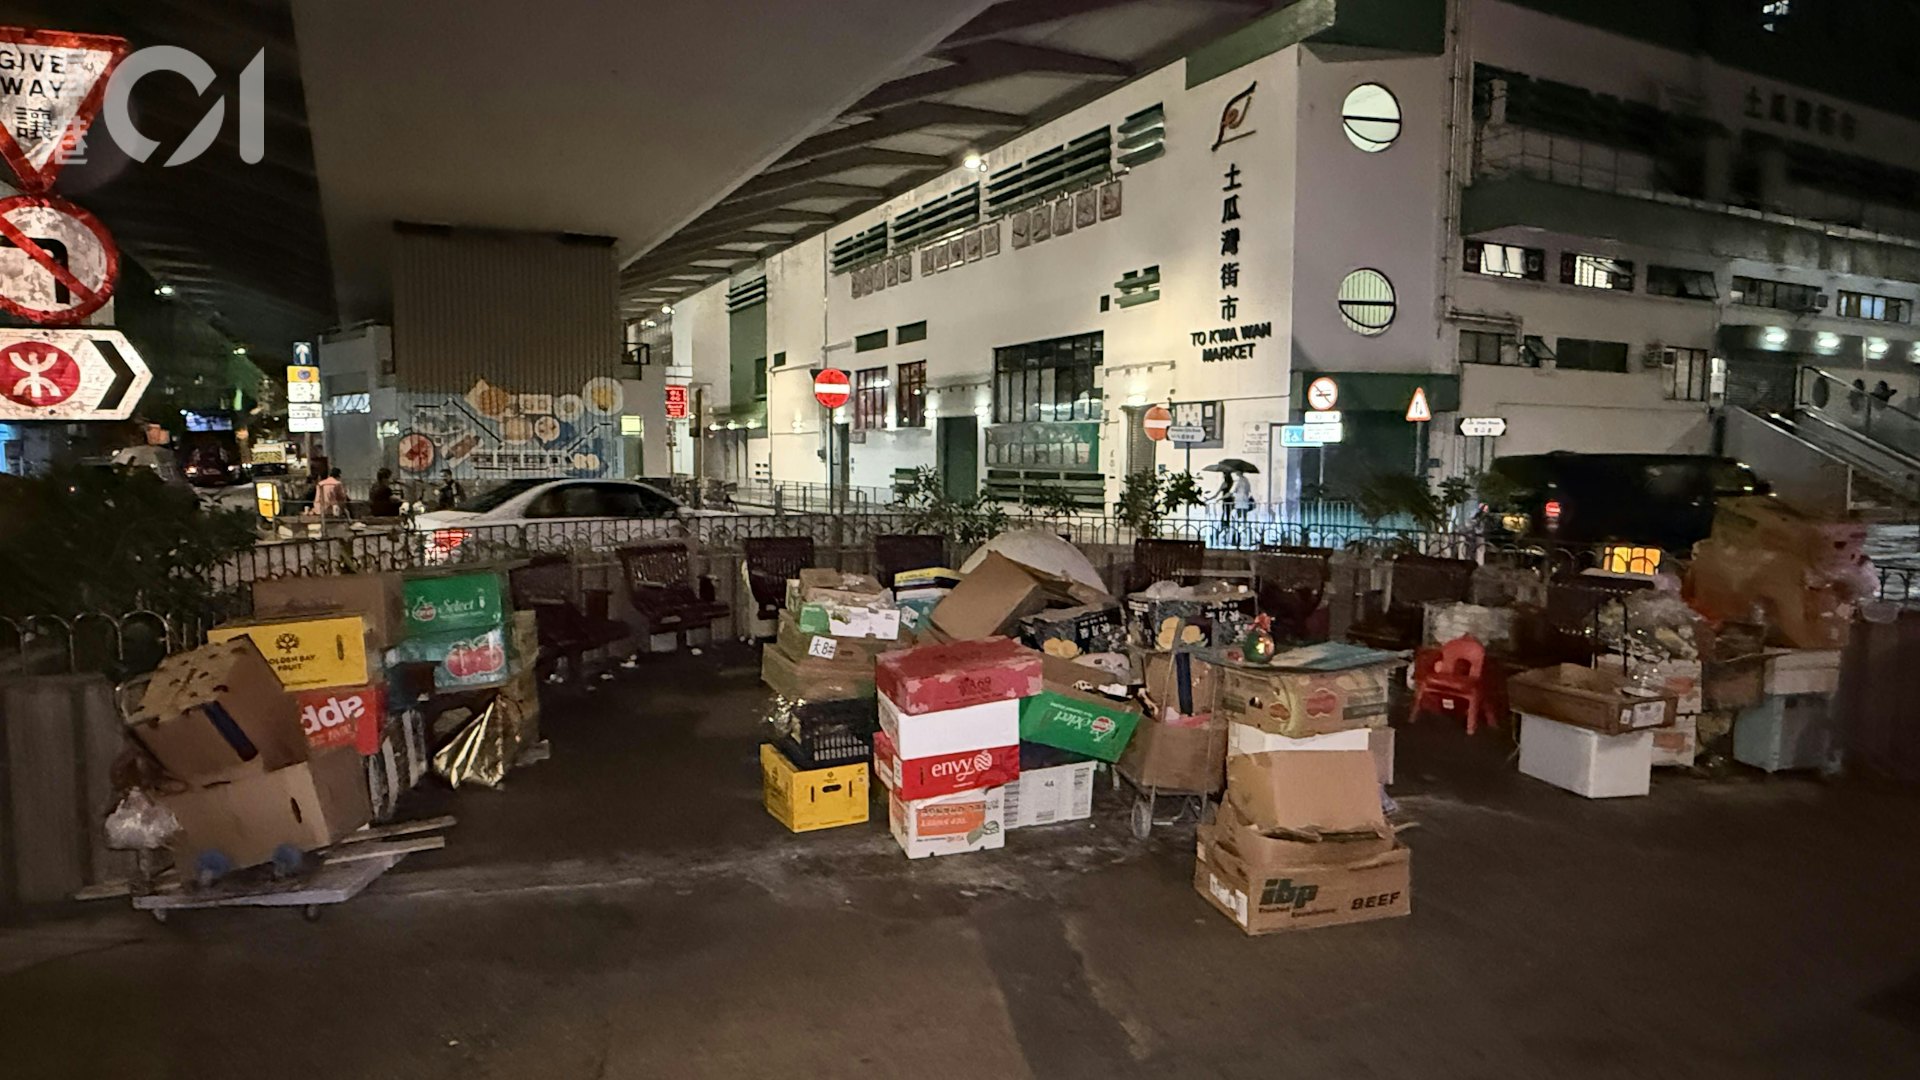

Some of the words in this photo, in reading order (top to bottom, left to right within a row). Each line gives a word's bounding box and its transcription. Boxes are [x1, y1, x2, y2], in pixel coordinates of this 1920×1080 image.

[0, 50, 65, 74] GIVE
[0, 77, 65, 99] WAY
[15, 106, 57, 139] 讓
[1219, 163, 1242, 322] 土瓜灣街市
[1190, 332, 1206, 347] TO
[1209, 327, 1239, 344] KWA
[1240, 321, 1272, 340] WAN
[1202, 343, 1256, 363] MARKET
[267, 656, 298, 666] OLDEN
[299, 654, 316, 663] BAY
[277, 663, 303, 672] FRUIT
[931, 757, 976, 782] envy
[1259, 878, 1319, 909] ibp
[1351, 892, 1401, 911] BEEF
